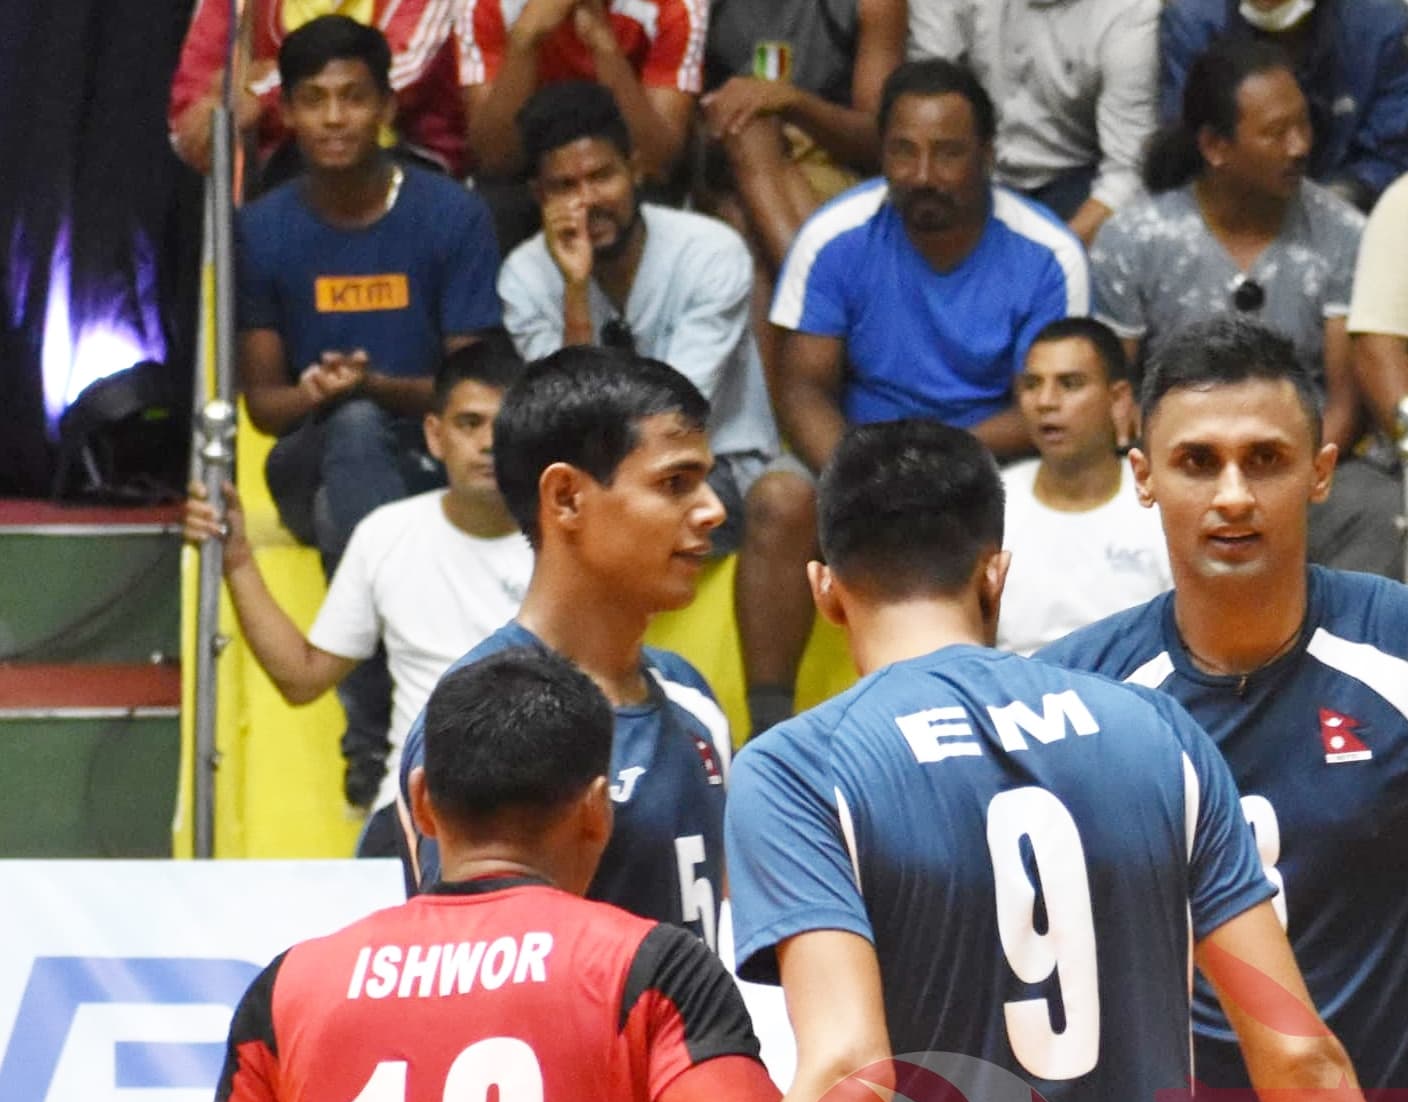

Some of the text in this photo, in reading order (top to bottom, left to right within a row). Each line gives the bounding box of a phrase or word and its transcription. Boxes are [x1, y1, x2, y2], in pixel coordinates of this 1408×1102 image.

[330, 281, 393, 304] KTM
[895, 689, 1100, 763] EM
[674, 834, 717, 953] 5
[346, 931, 553, 999] ISHWOR
[986, 786, 1101, 1081] 9
